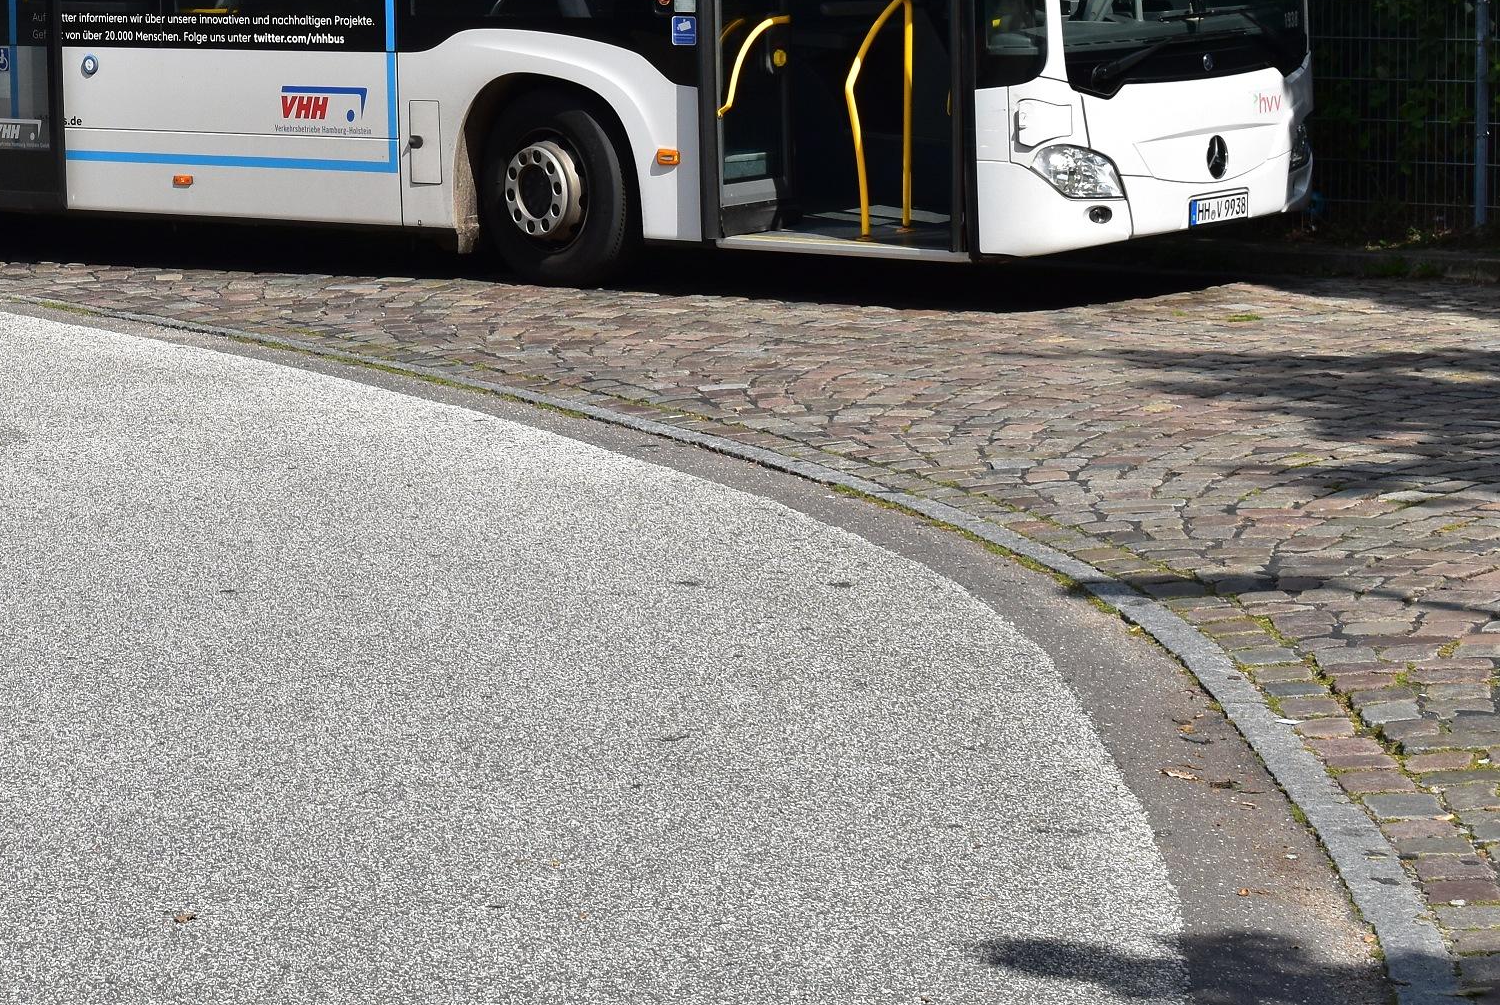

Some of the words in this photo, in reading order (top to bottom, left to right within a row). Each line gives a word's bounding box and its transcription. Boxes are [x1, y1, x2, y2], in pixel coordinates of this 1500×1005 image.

[61, 13, 76, 23] tter
[79, 12, 128, 24] informieren
[130, 13, 143, 24] wir
[145, 13, 165, 24] über
[167, 16, 197, 24] unsere
[199, 14, 250, 25] innovativen
[252, 15, 270, 25] und
[272, 15, 332, 28] nachhaltigen
[334, 15, 375, 28] Projekte.
[65, 32, 81, 40] von
[82, 30, 102, 41] über
[104, 30, 133, 41] 20.000
[135, 31, 182, 42] Menschen.
[183, 32, 207, 44] Folge
[209, 34, 226, 43] uns
[227, 33, 251, 43] unter
[253, 33, 345, 45] twitter.com/vhhbus
[281, 95, 329, 120] VHH
[1258, 92, 1282, 113] hvv
[63, 116, 82, 126] s.de
[1197, 201, 1211, 221] HH
[1217, 200, 1223, 218] V
[1224, 196, 1247, 217] 9938
